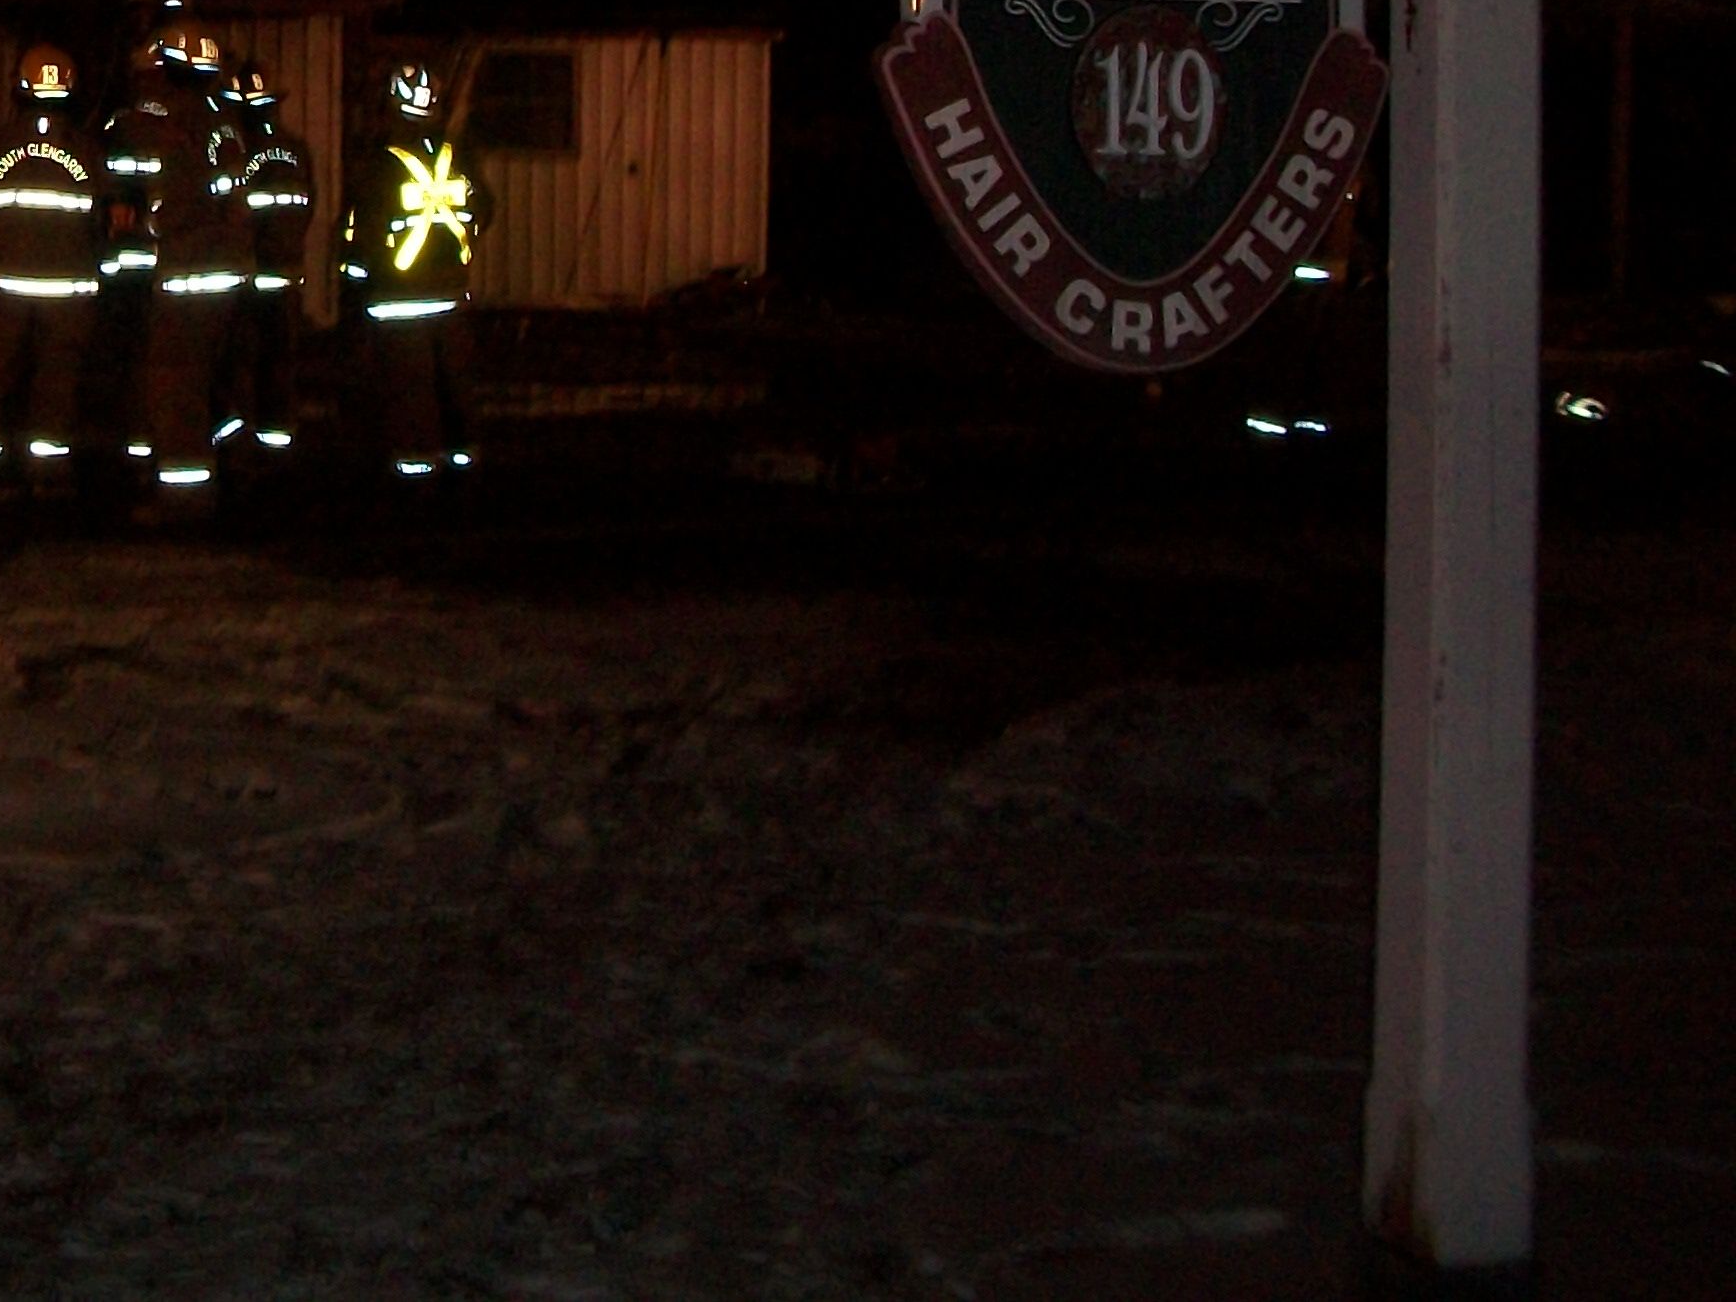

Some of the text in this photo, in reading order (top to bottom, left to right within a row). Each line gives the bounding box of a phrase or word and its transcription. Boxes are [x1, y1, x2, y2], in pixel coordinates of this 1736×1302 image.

[1093, 41, 1216, 160] 149
[27, 142, 89, 182] GLENGARRY
[924, 97, 1356, 354] HAIR CRAFTERS
